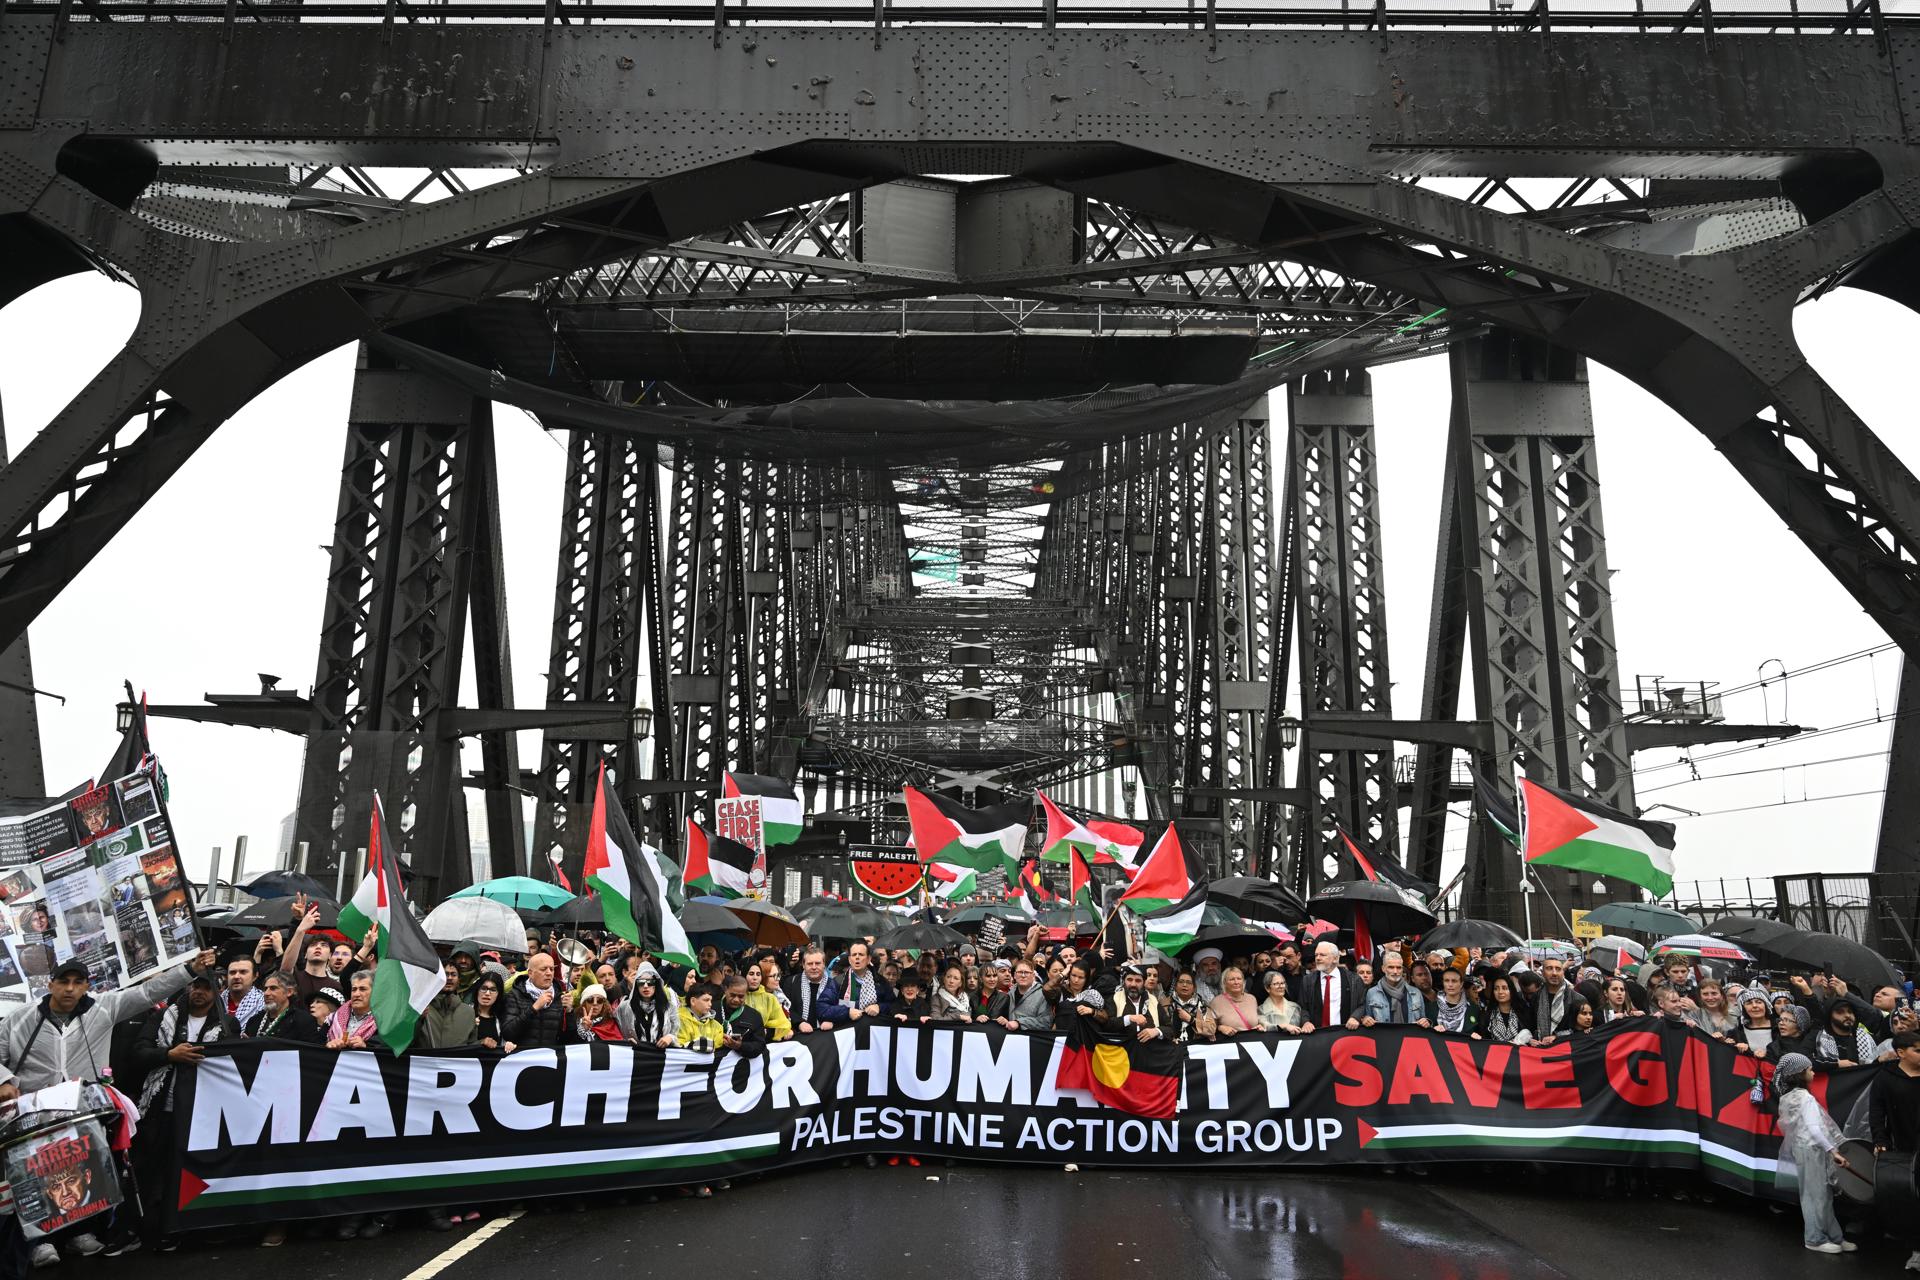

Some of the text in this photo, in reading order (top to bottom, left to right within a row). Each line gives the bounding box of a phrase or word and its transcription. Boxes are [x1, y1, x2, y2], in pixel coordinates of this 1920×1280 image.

[718, 799, 760, 818] CEASE
[27, 825, 42, 833] STOP
[718, 815, 760, 841] FIRE
[849, 850, 873, 858] FREE
[1702, 949, 1738, 957] PALESTINE
[187, 1042, 636, 1153] MARCH
[657, 1040, 821, 1121] FOR
[833, 1025, 1303, 1110] HUMATY
[1330, 1035, 1583, 1110] SAVE
[791, 1106, 1343, 1154] PALESTINE ACTION GROUP
[26, 1135, 91, 1173] ARREST
[40, 1197, 109, 1232] WAR CRIMINAL
